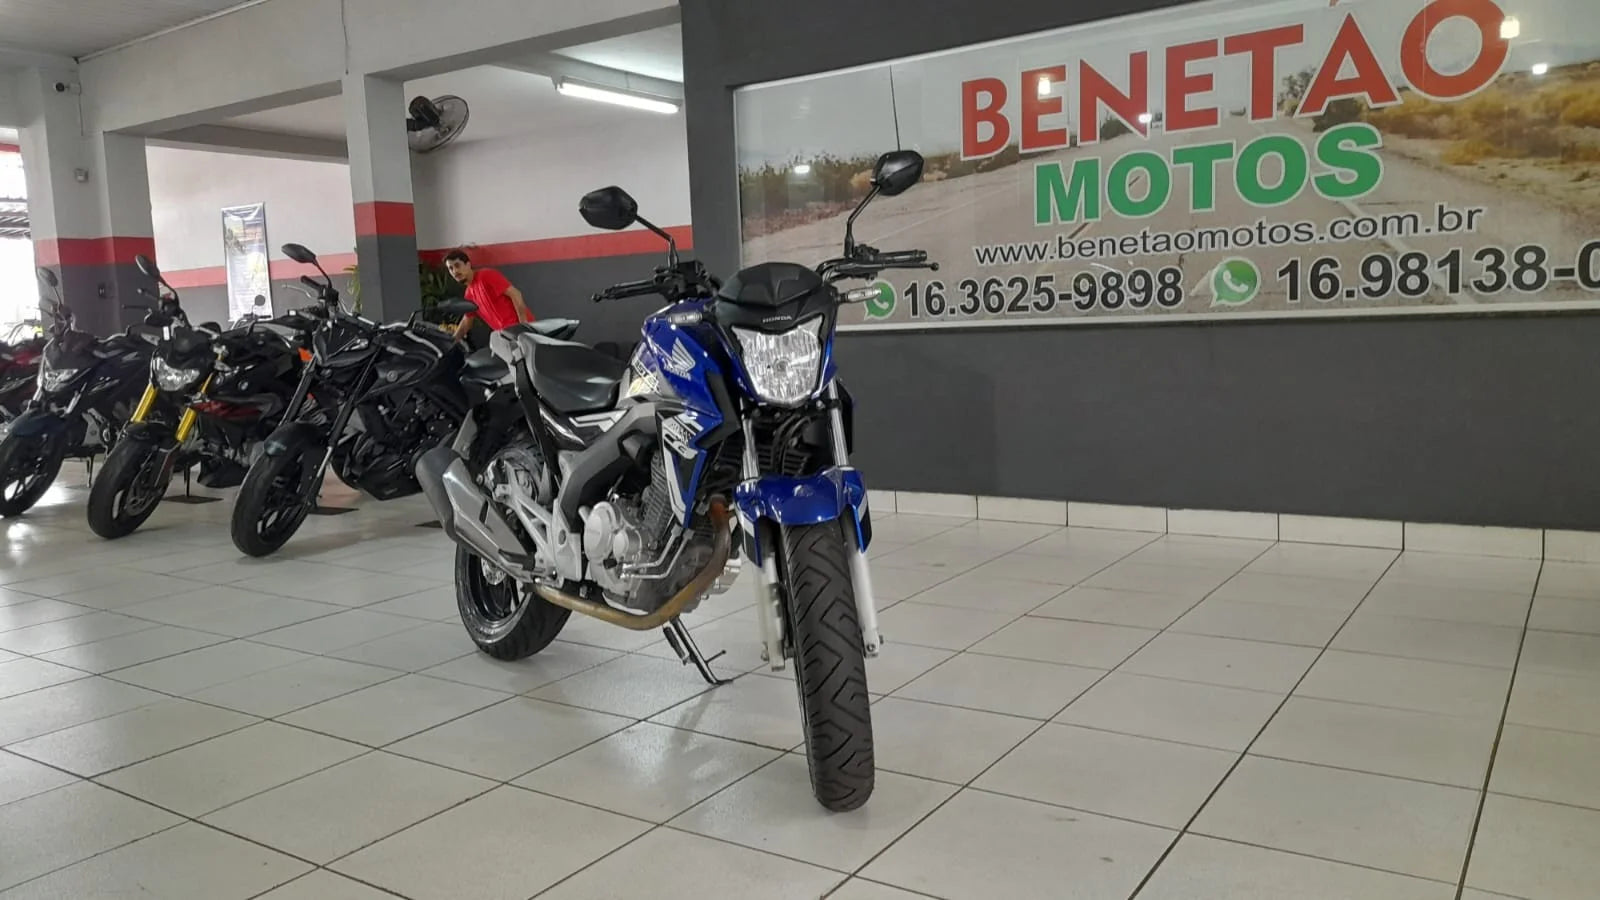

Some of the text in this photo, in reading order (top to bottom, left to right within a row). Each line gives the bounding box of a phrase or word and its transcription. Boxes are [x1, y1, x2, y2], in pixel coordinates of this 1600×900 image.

[1036, 124, 1382, 225] MOTOS
[976, 205, 1482, 263] www.benetaomotos.com.br
[762, 315, 793, 323] HONDA
[904, 267, 1183, 317] 16.3625-9898
